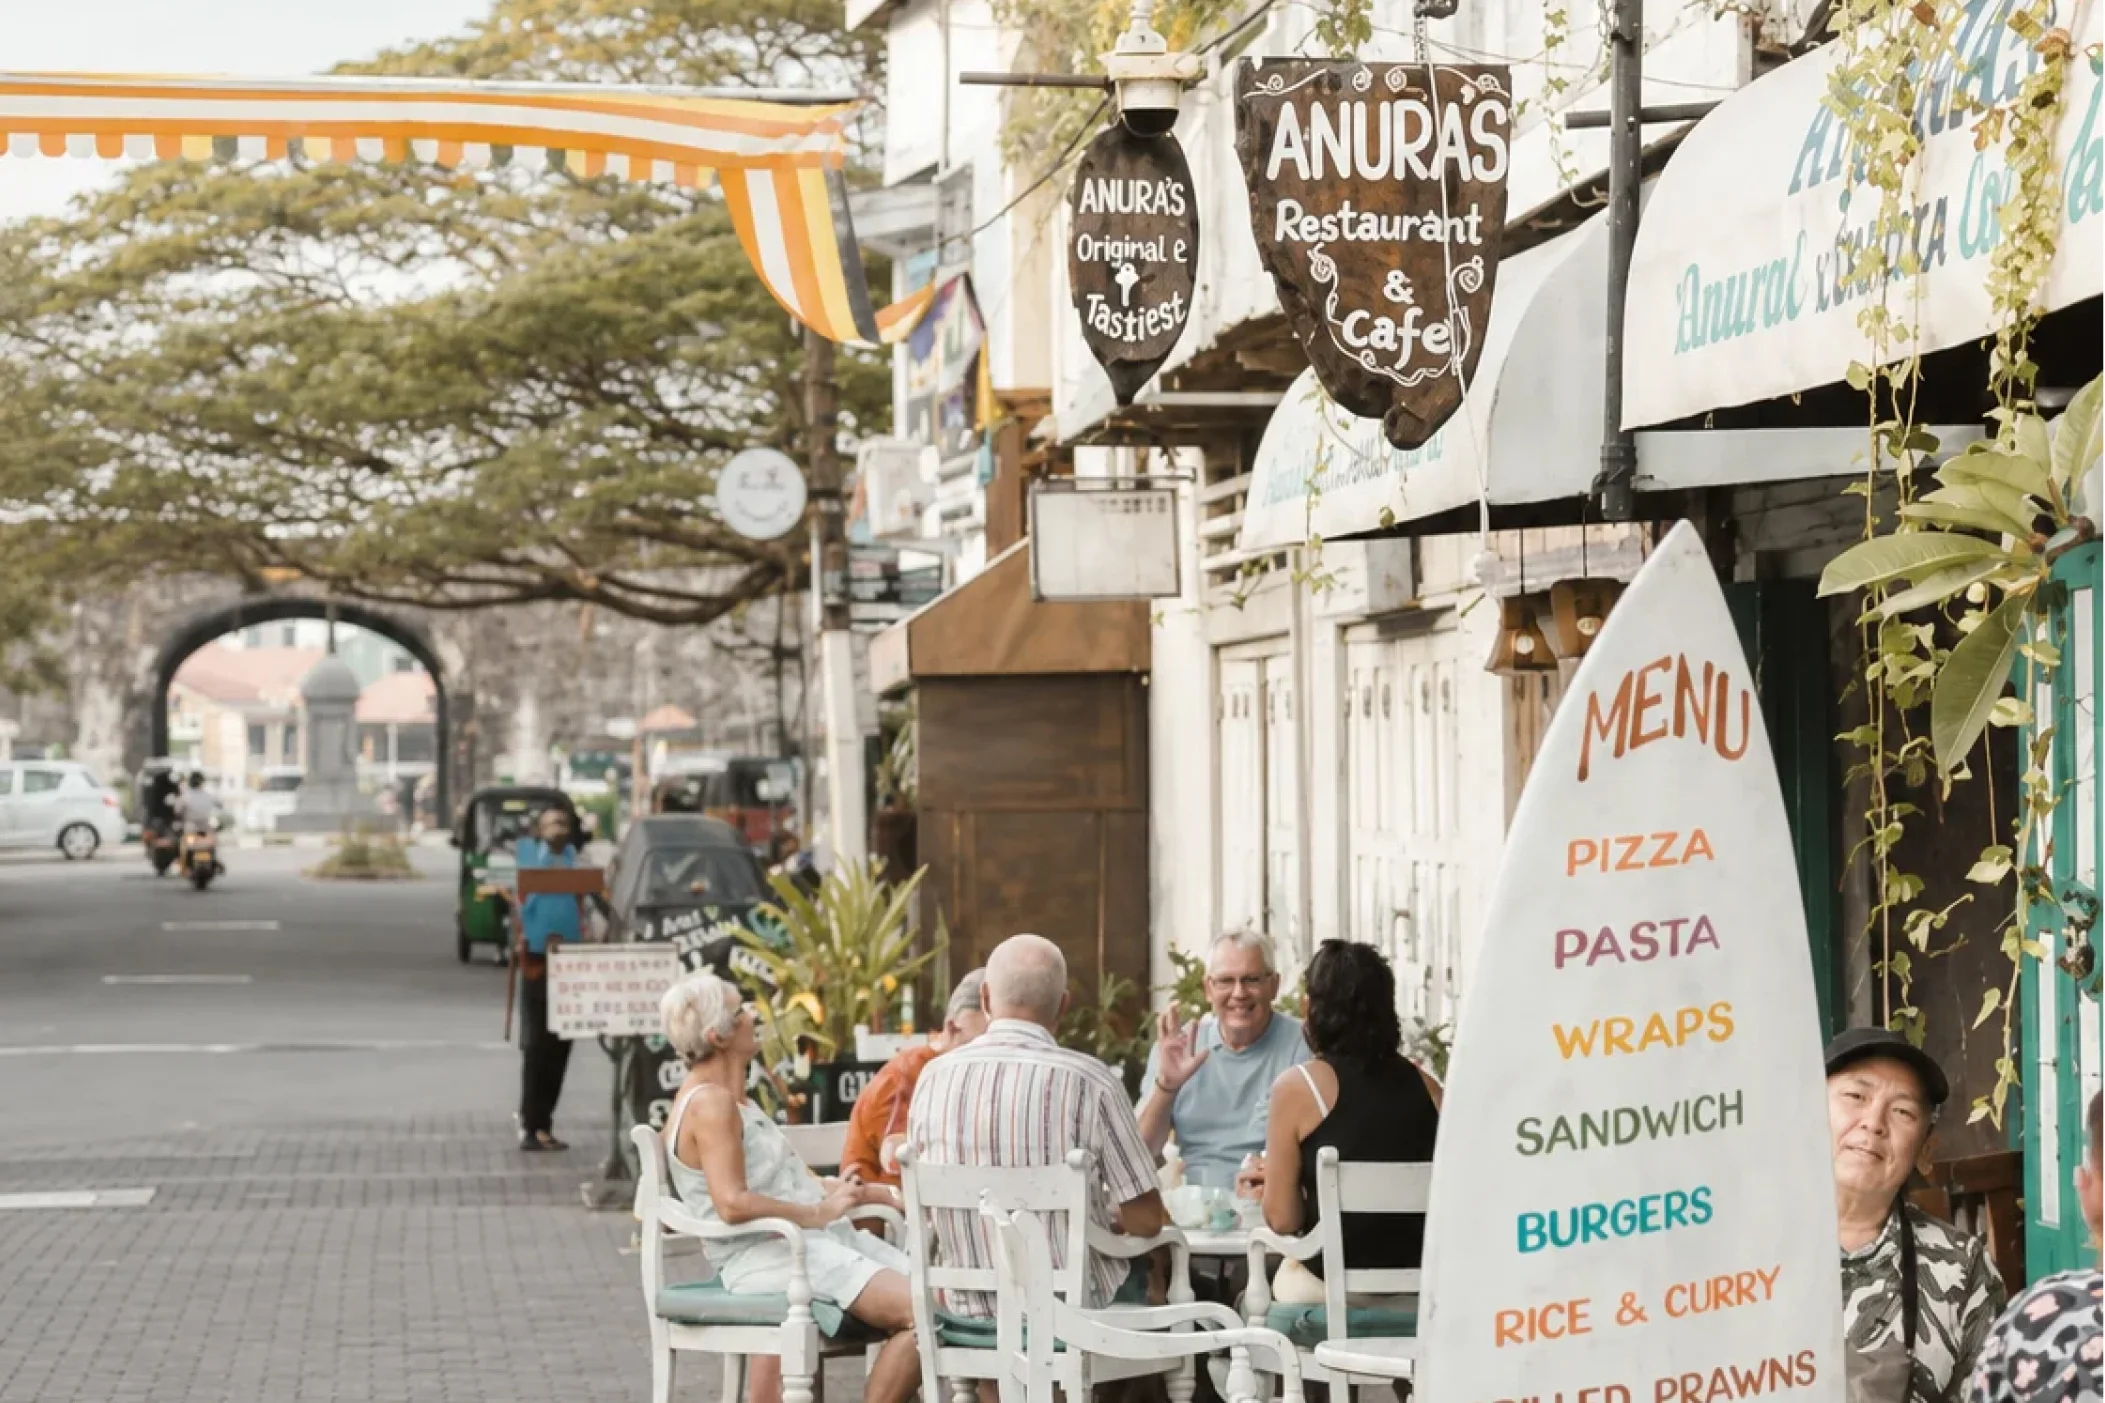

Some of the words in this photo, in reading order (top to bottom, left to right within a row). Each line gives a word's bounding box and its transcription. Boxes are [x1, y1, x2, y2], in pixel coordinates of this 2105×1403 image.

[1266, 84, 1508, 183] ANURA'S
[1079, 176, 1187, 217] ANURA'S
[1275, 198, 1484, 246] Restaurant
[1077, 232, 1168, 269] Original
[1383, 269, 1415, 305] &
[1086, 290, 1187, 342] Tastiest
[1577, 653, 1750, 782] MENU
[1566, 828, 1715, 877] PIZZA
[1554, 914, 1721, 969] PASTA
[1552, 1001, 1736, 1060] WRAPS
[1515, 1090, 1744, 1157] SANDWICH
[1517, 1185, 1713, 1254] BURGERS
[1495, 1298, 1593, 1348] RICE
[1615, 1291, 1649, 1327] &
[1664, 1265, 1781, 1318] CURRY
[1654, 1350, 1816, 1403] PRAWNS
